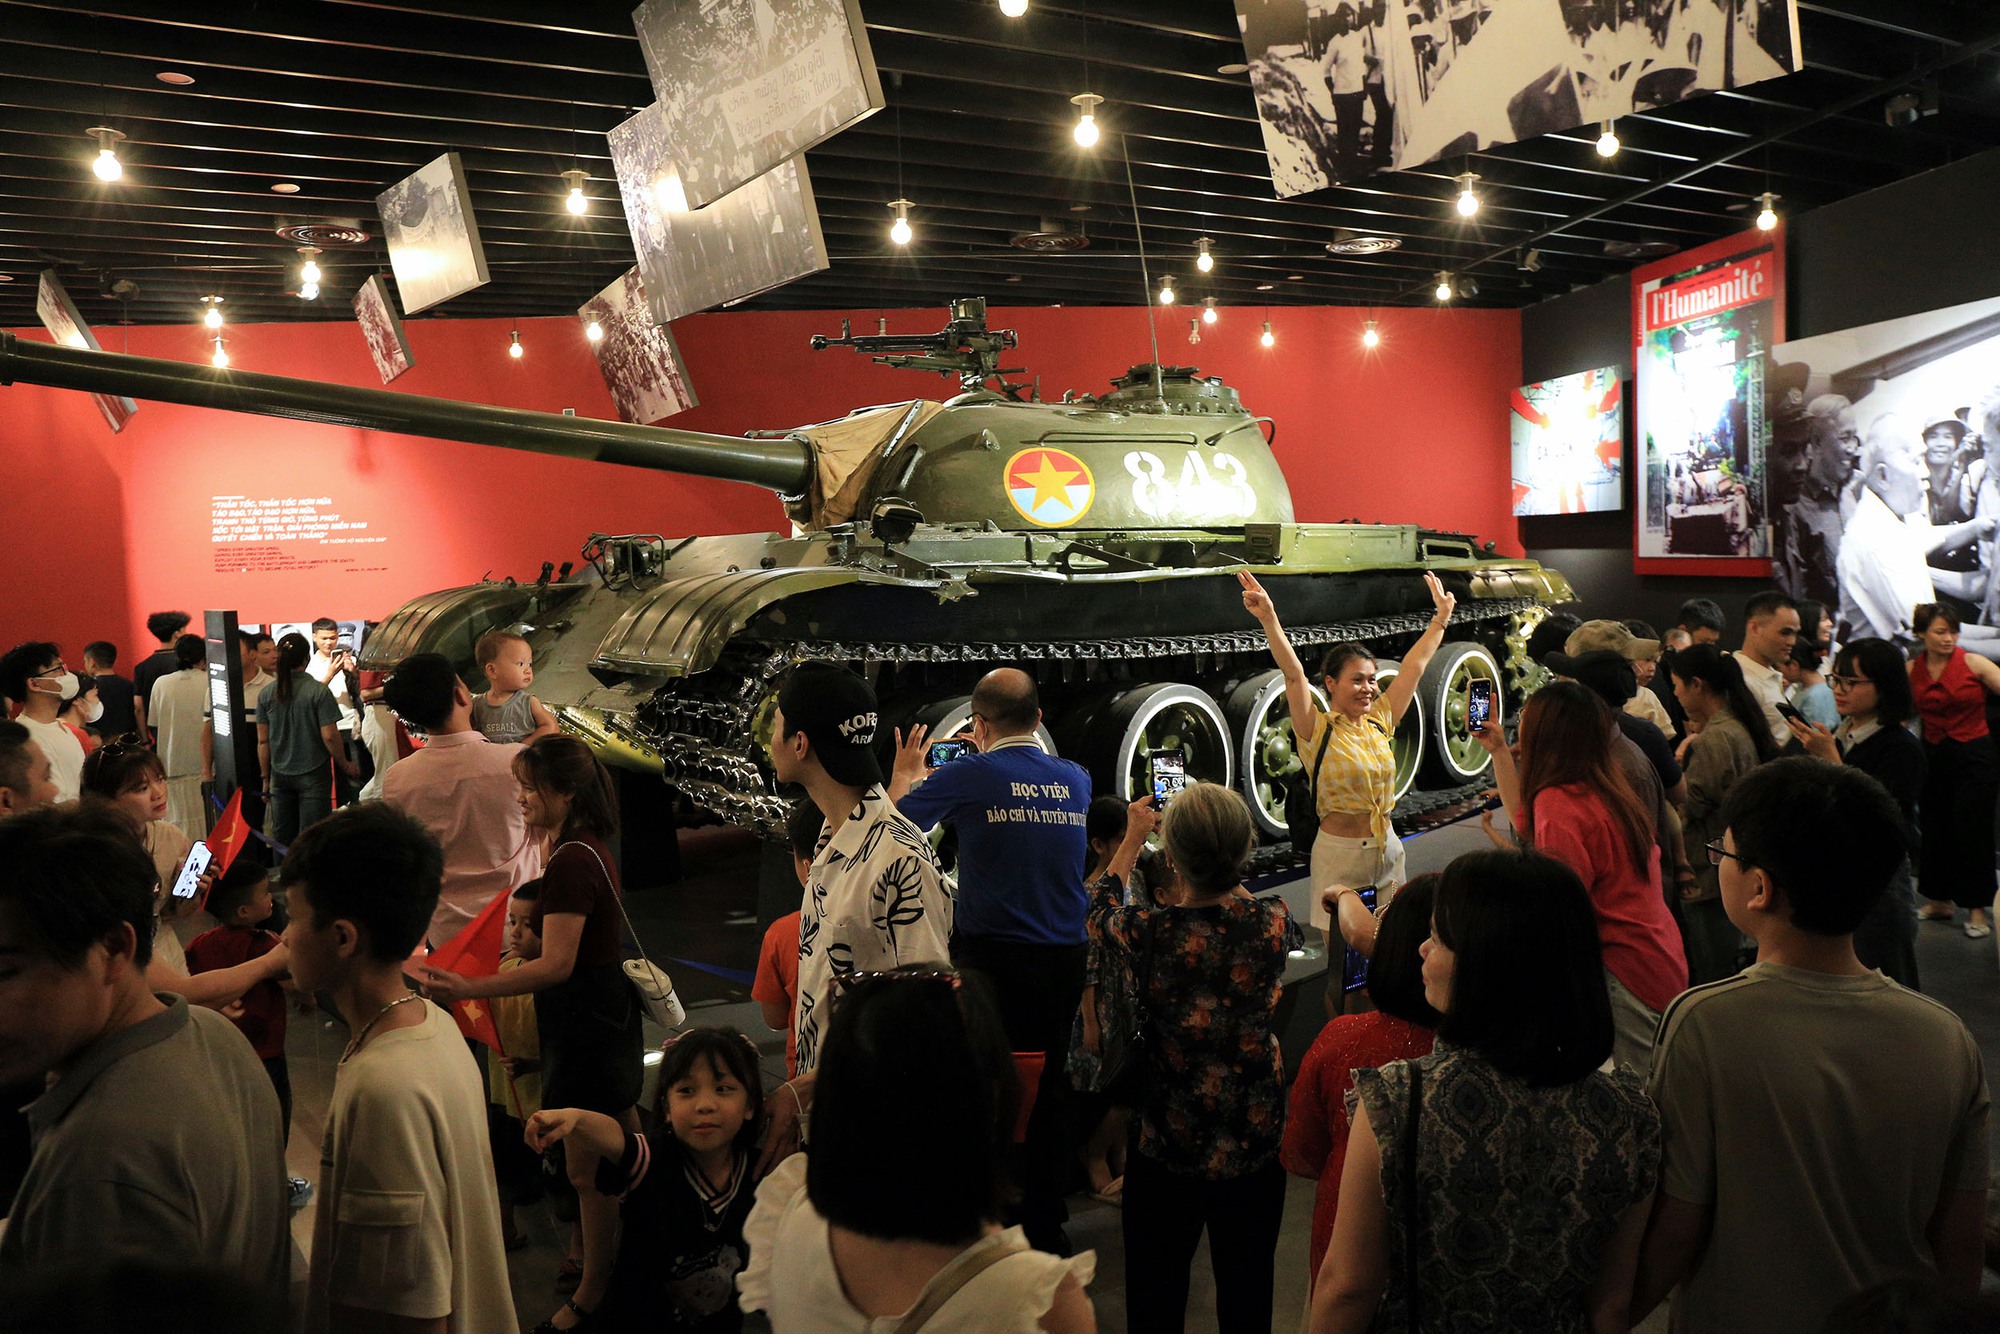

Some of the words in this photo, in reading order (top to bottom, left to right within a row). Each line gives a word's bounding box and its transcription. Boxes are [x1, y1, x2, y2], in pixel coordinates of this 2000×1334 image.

[1652, 259, 1764, 325] l'Humanité
[1123, 450, 1257, 518] 843
[1010, 782, 1039, 800] HỌC
[1040, 781, 1070, 802] VIỆN
[986, 806, 1007, 823] BÁO
[1009, 805, 1026, 822] CHÍ
[1026, 806, 1041, 823] VÀ
[1041, 808, 1068, 825] TUYÊN
